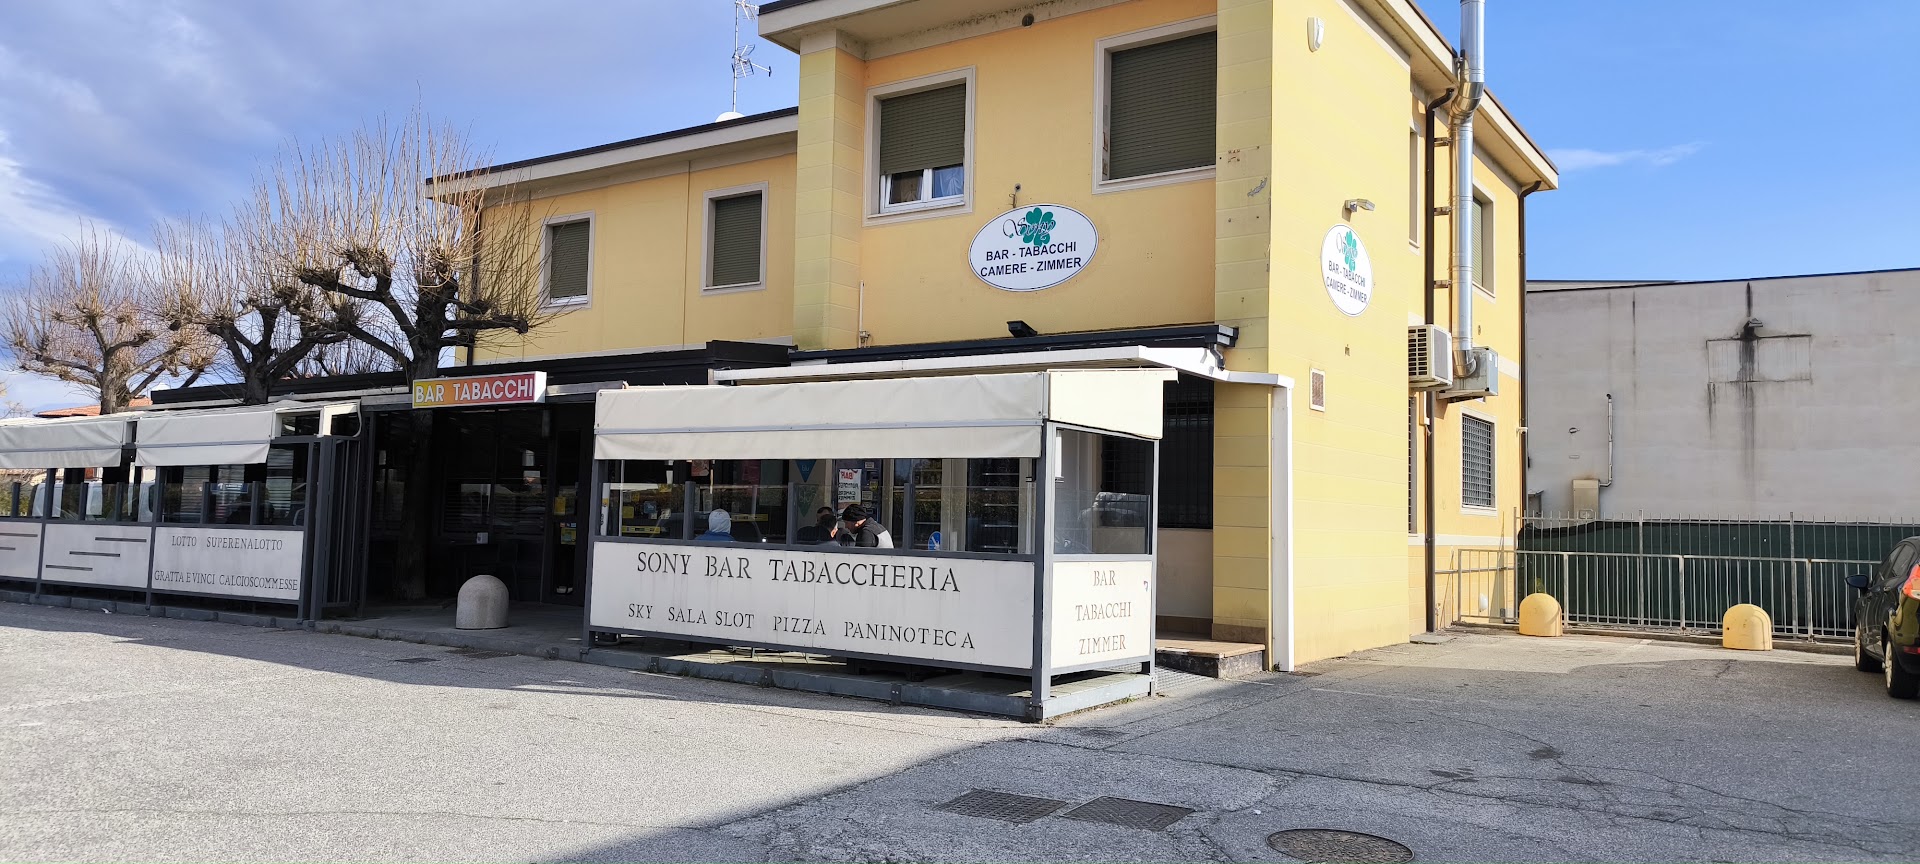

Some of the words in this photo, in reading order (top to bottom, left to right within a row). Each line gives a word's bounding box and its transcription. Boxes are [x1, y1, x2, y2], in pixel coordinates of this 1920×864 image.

[986, 249, 1009, 261] BAR
[1019, 241, 1076, 258] TABACCHI
[980, 263, 1027, 277] CAMERE
[1036, 257, 1081, 272] ZIMMER
[1328, 260, 1339, 275] BAR
[1342, 267, 1366, 287] TABACCHI
[1326, 276, 1347, 295] CAMERE
[1350, 287, 1368, 304] ZIMMER
[416, 384, 445, 403] BAR
[453, 378, 533, 401] TABACCHI
[172, 536, 197, 547] LOTTO
[206, 537, 283, 550] SUPERENALOTTO
[154, 570, 184, 583] GRATTA
[637, 552, 691, 575] SONY
[704, 555, 752, 579] BAR
[769, 559, 961, 592] TABACCHERIA
[1093, 570, 1116, 586] BAR
[1075, 601, 1131, 622] TABACCHI
[628, 603, 653, 620] SKY
[668, 606, 707, 625] SALA
[715, 610, 755, 629] SLOT
[773, 616, 826, 635] PIZZA
[844, 621, 975, 650] PANINOTECA
[1079, 634, 1126, 655] ZIMMER
